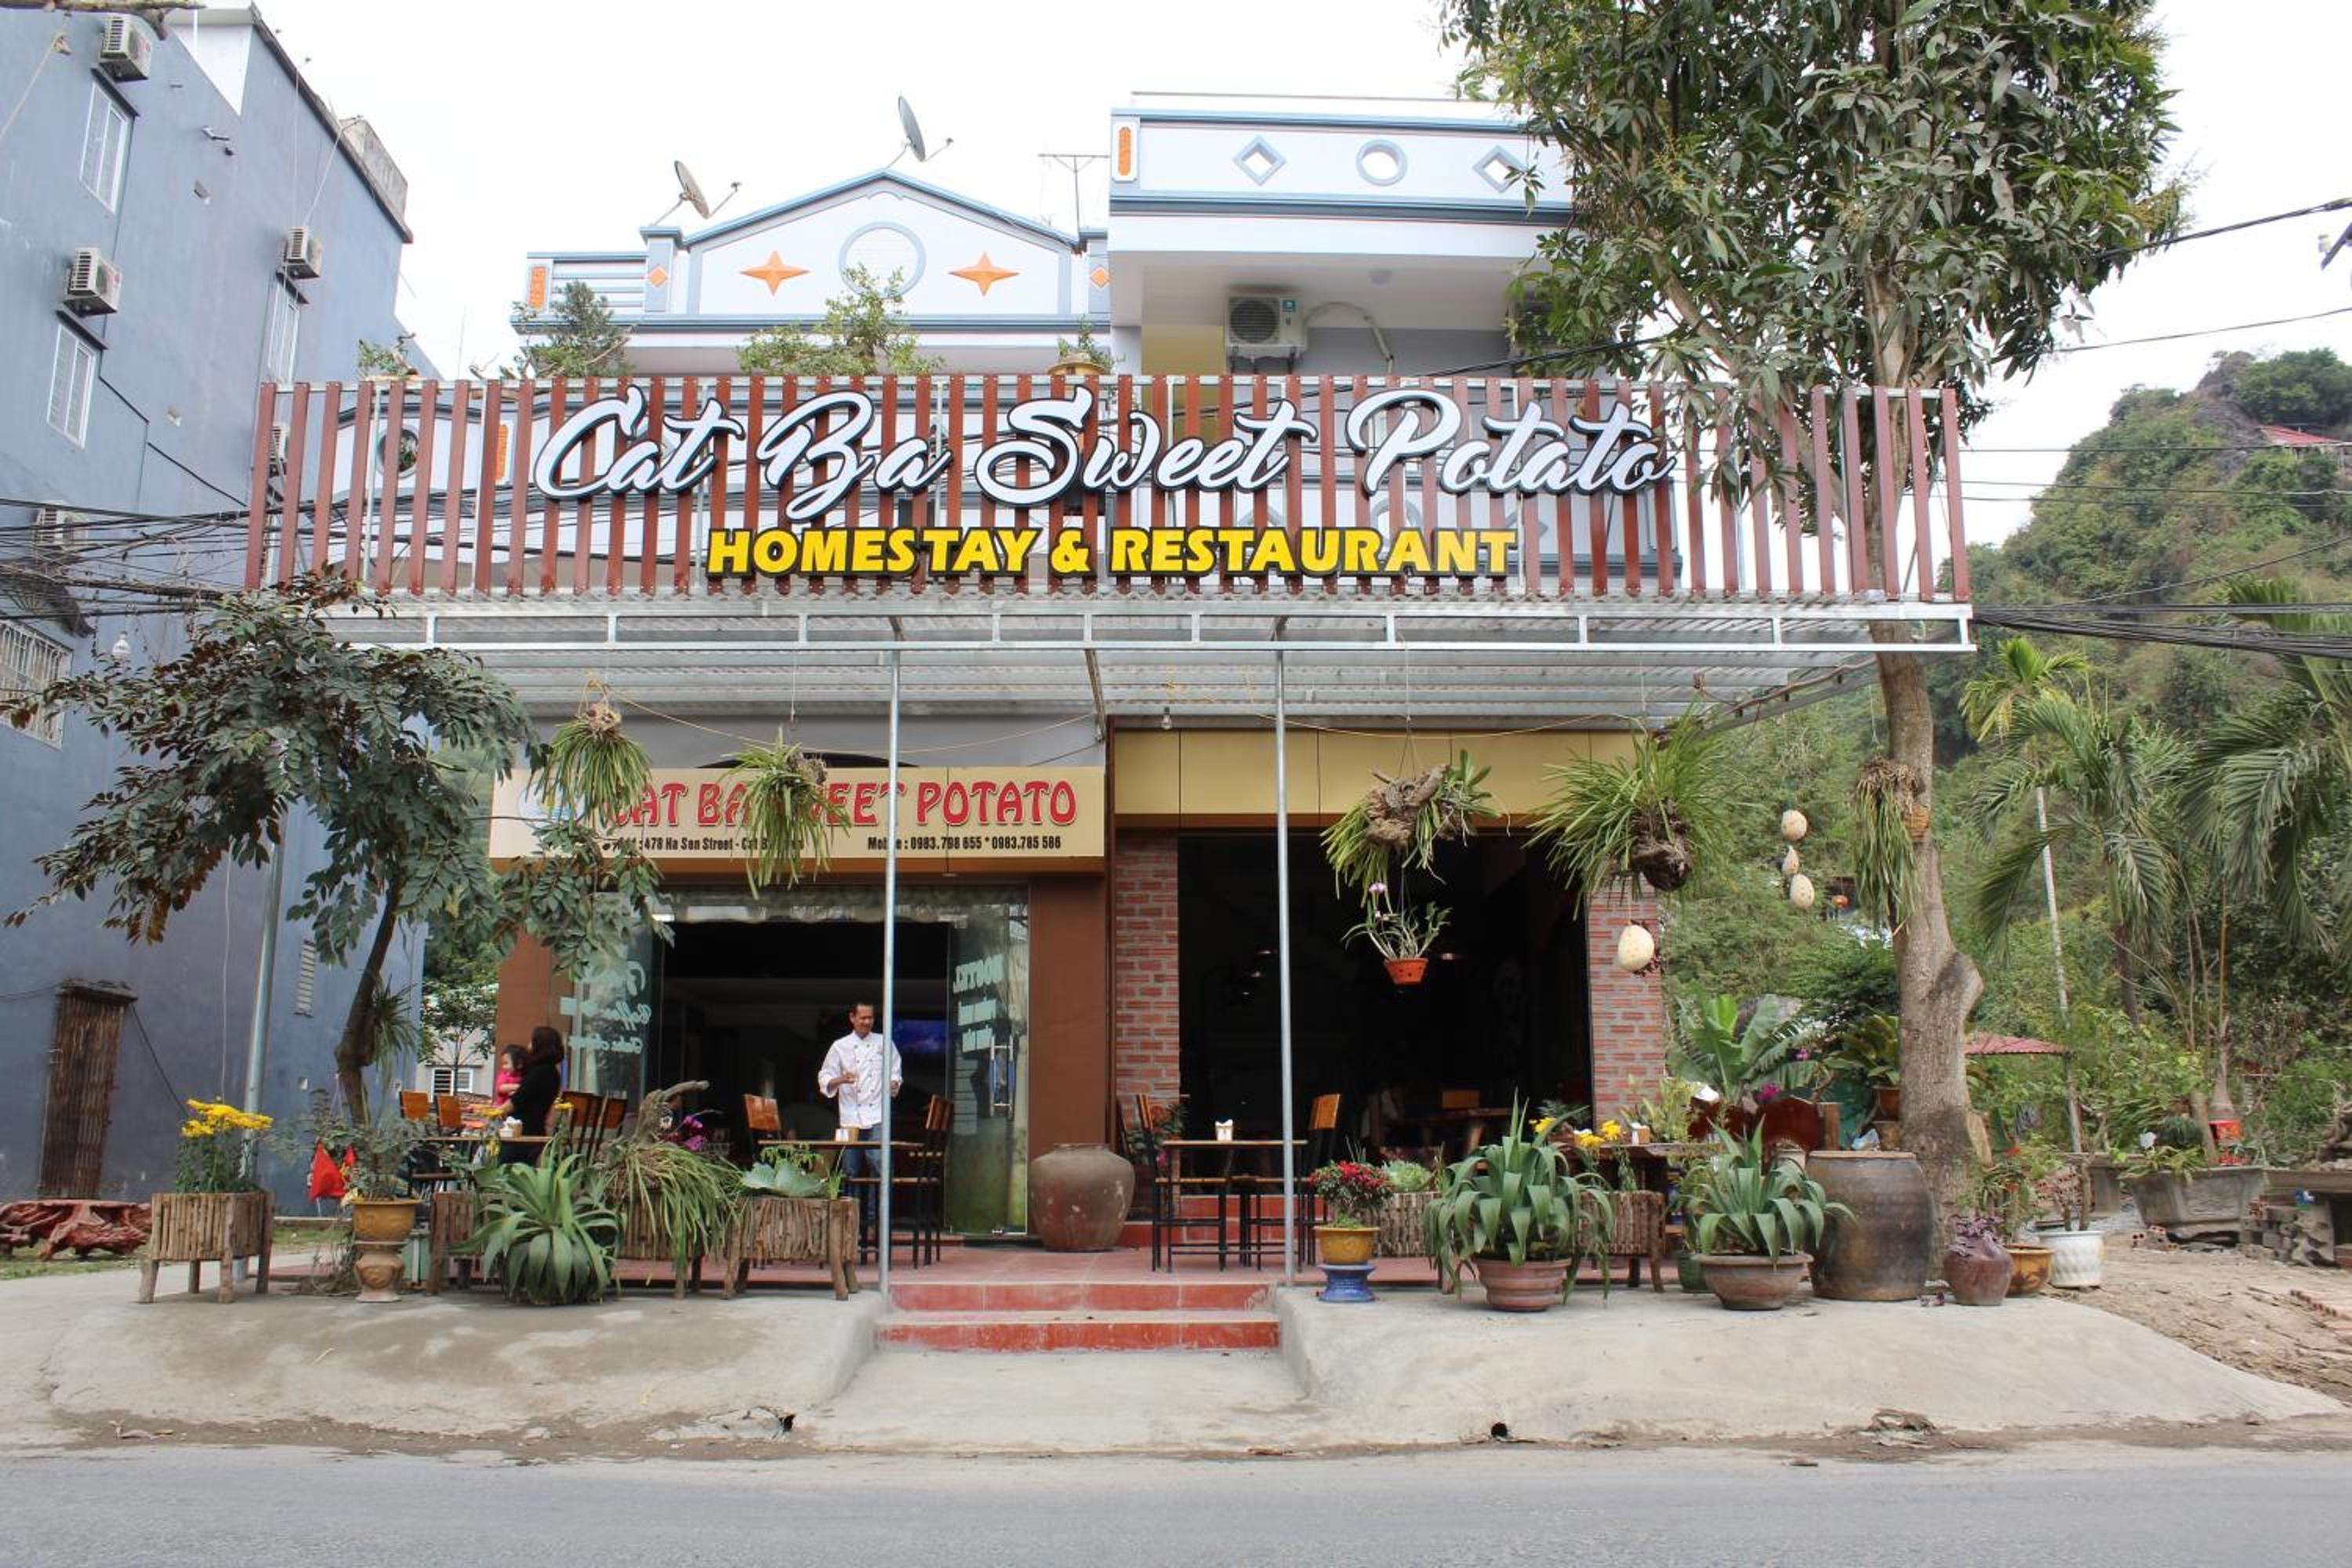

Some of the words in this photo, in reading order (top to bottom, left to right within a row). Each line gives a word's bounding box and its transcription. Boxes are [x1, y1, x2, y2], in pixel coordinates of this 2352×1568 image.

[534, 385, 745, 502] Cat
[755, 390, 952, 523] Ba
[973, 384, 1318, 509] Sweet
[1345, 389, 1679, 495] Potato
[706, 527, 1044, 577] HOMESTAY
[1049, 528, 1092, 577] &
[1108, 526, 1518, 577] RESTAURANT
[604, 782, 690, 826] AT
[916, 781, 1077, 826] POTATO
[666, 837, 678, 851] Ha
[702, 837, 734, 851] Street
[868, 837, 901, 850] Mobe
